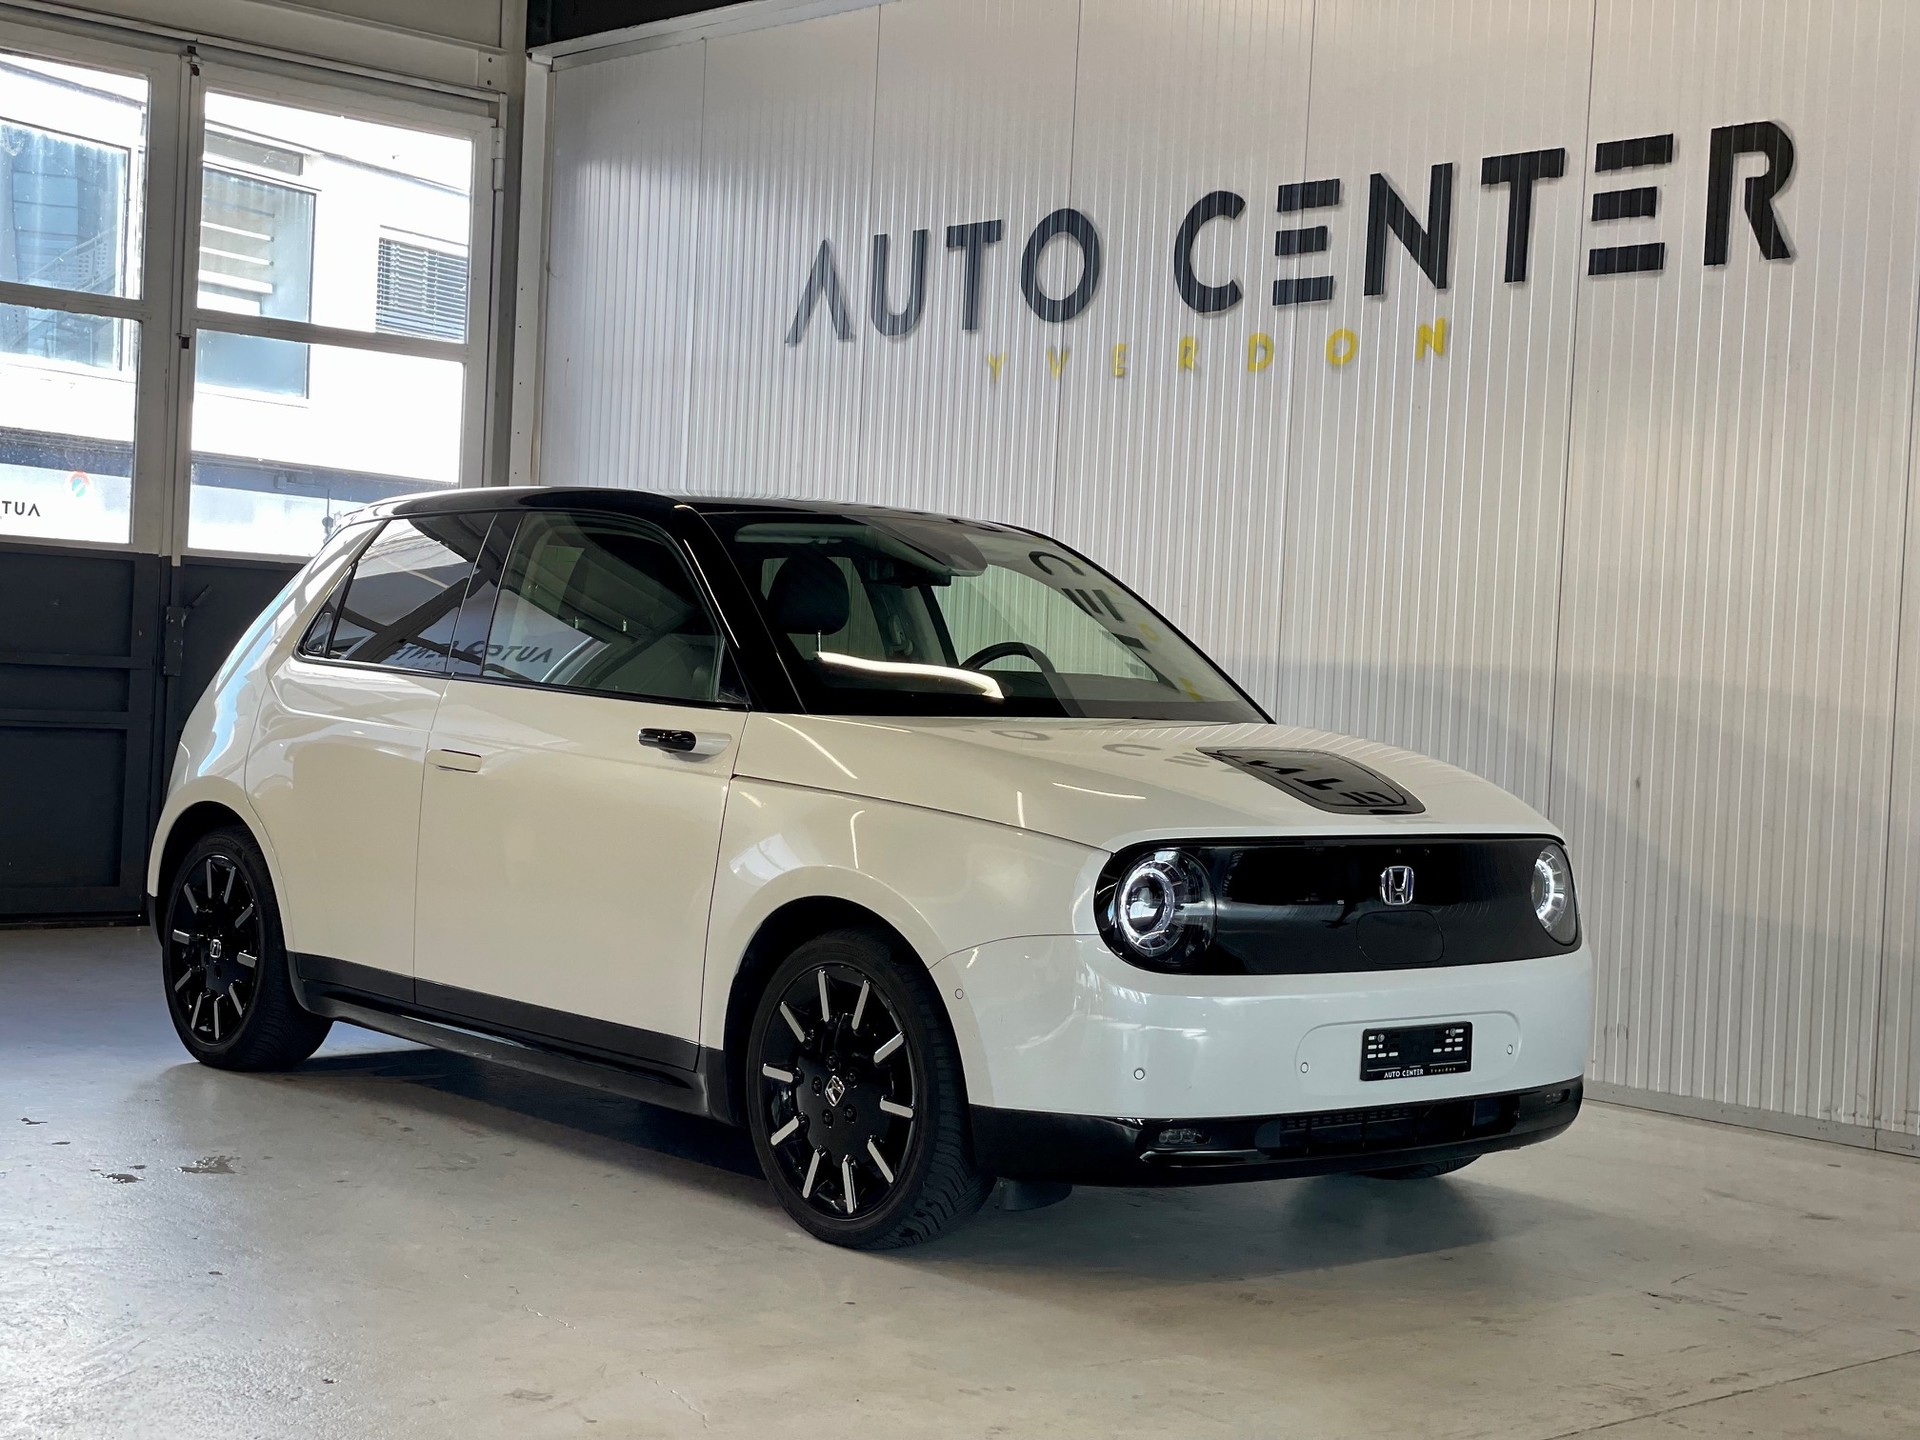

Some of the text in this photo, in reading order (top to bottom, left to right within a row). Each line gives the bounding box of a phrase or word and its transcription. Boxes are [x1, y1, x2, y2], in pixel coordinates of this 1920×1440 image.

[784, 120, 1795, 345] AUTO CENTER
[986, 317, 1448, 383] YVERDON
[1384, 1070, 1400, 1078] AUTO
[1401, 1068, 1424, 1077] CENTER
